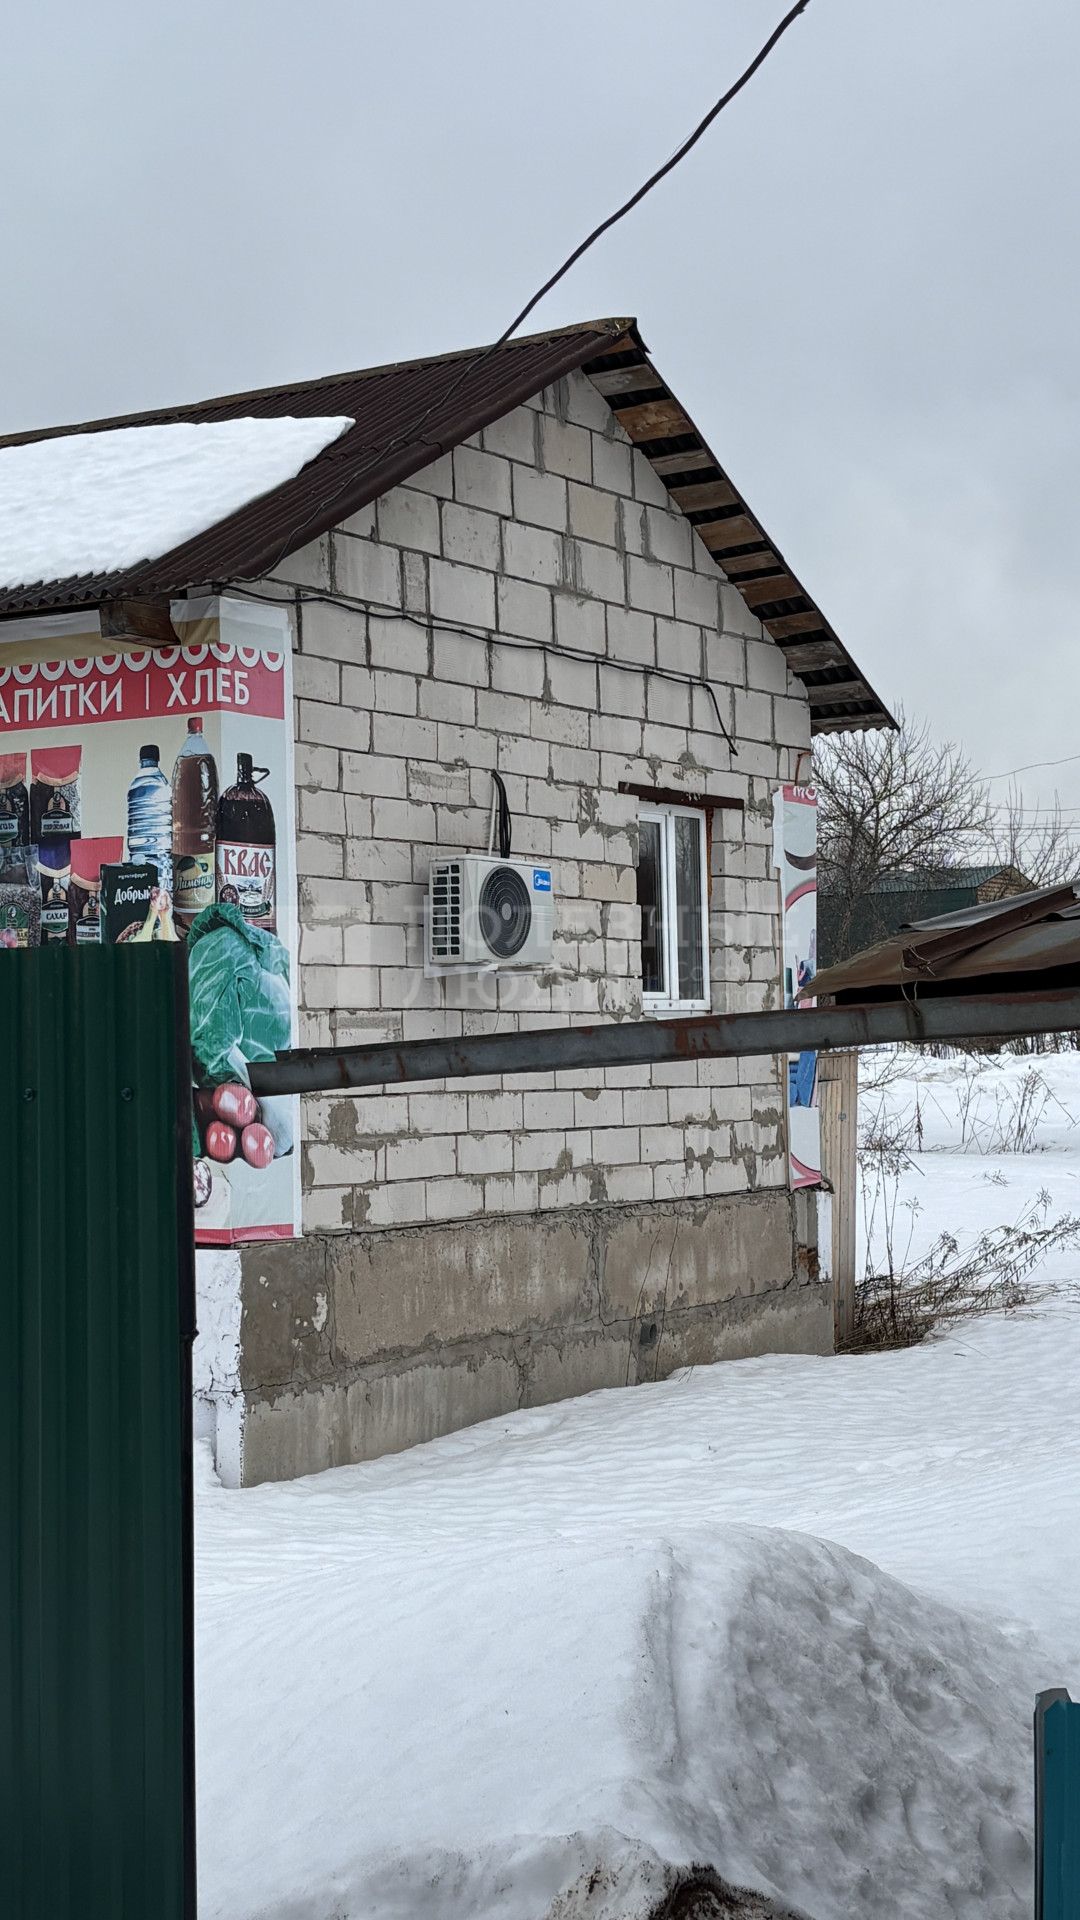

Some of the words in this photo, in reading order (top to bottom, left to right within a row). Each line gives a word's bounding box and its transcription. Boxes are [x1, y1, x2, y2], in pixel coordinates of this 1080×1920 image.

[166, 668, 250, 708] ХЛЕБ
[223, 848, 271, 878] КВАС
[46, 911, 68, 921] САХАР
